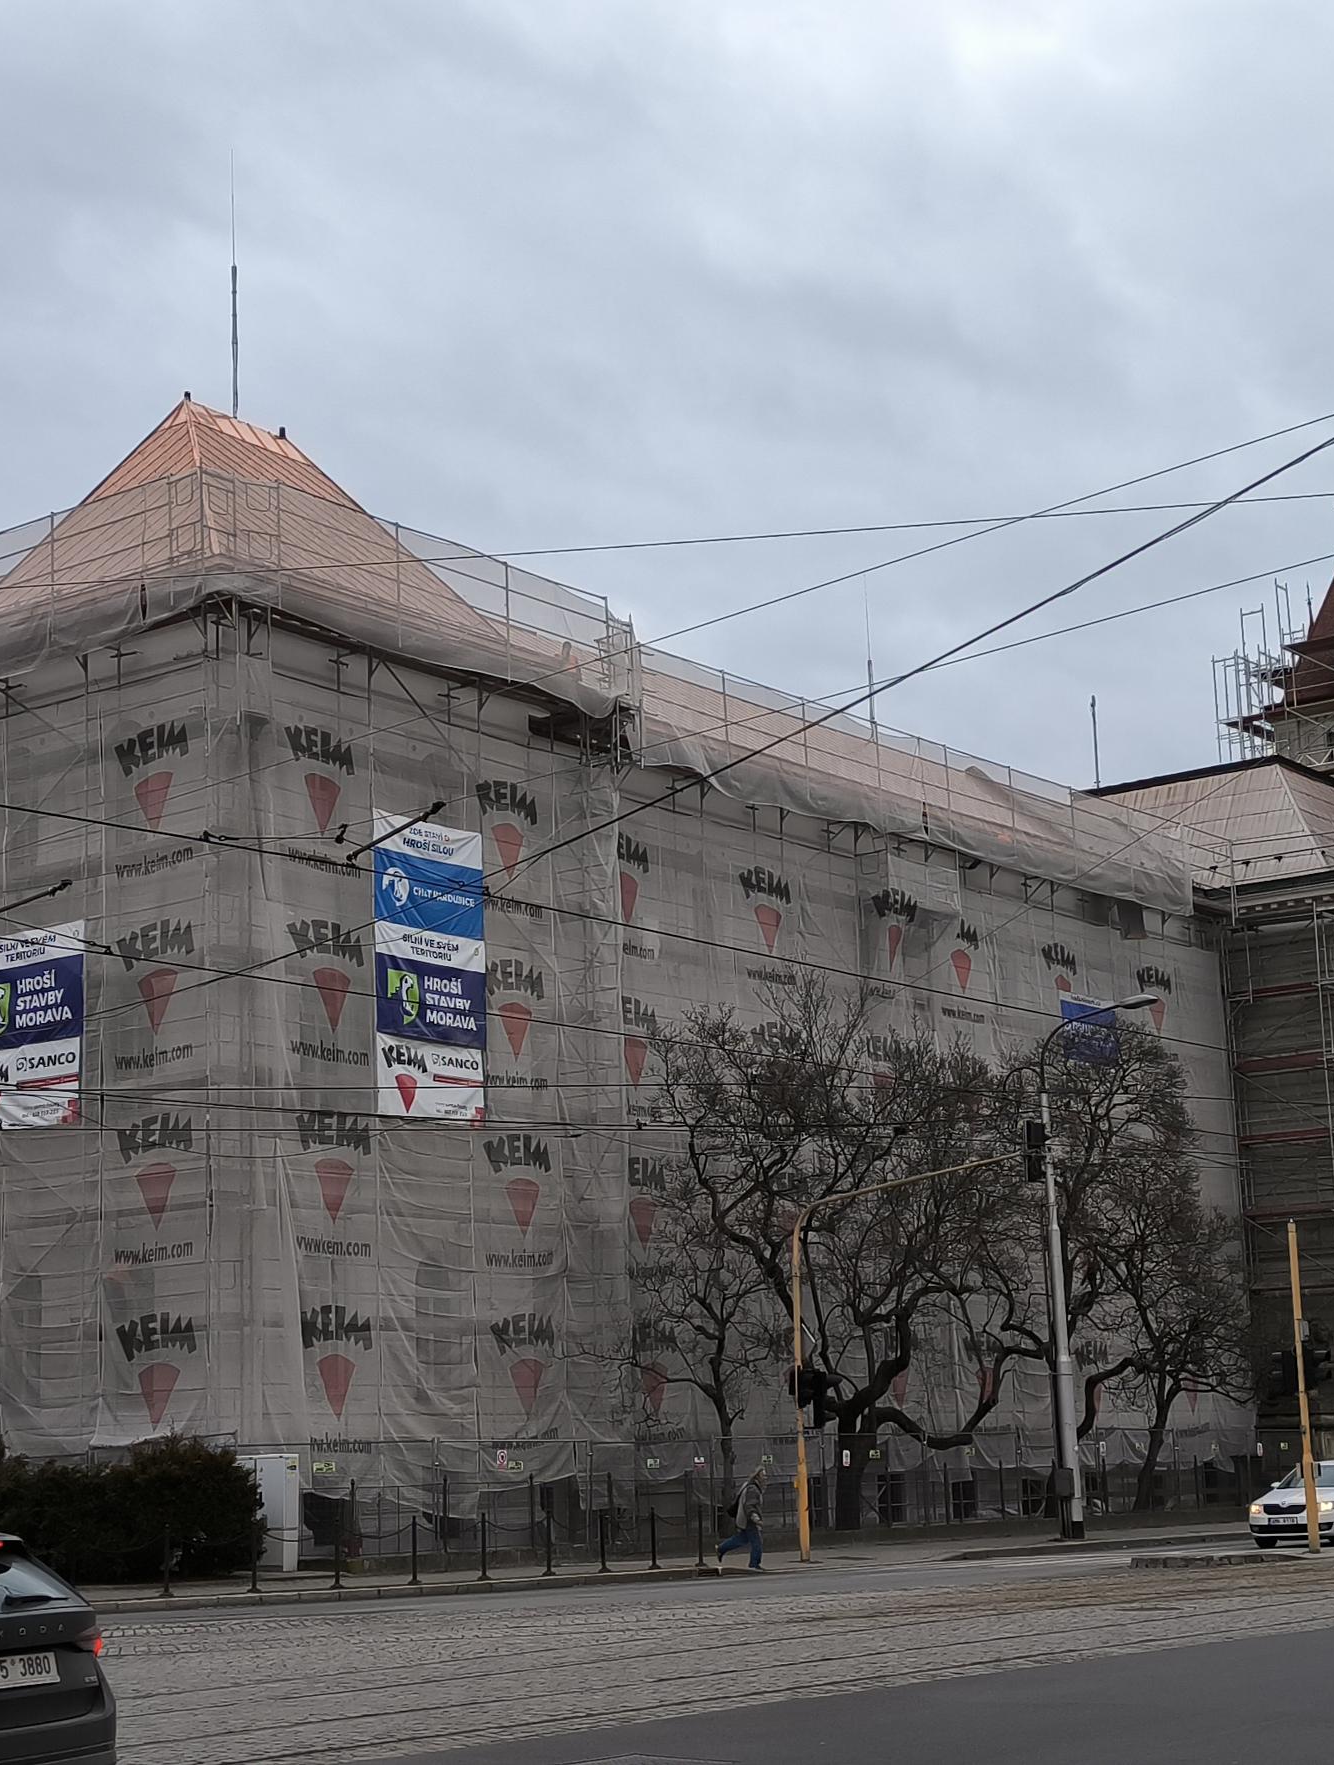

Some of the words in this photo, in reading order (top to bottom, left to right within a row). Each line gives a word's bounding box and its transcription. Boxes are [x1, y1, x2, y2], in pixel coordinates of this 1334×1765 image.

[114, 720, 189, 777] KEIM
[283, 724, 356, 776] KEIM
[475, 780, 538, 825] KEIM
[115, 846, 194, 880] www.keim.com
[431, 843, 454, 856] SILOU
[738, 866, 791, 905] KEIM
[116, 918, 195, 972] KEIM
[286, 918, 365, 968] KEIM
[17, 969, 55, 994] HROŠÍ
[424, 976, 462, 995] HROŠÍ
[1136, 965, 1171, 995] KEIM
[15, 989, 64, 1011] STAVBY
[425, 994, 471, 1012] STAVBY
[15, 1006, 72, 1029] MORAVA
[425, 1008, 477, 1031] MORAVA
[28, 1051, 76, 1070] SANCO
[115, 1042, 193, 1070] www.keim.com
[290, 1039, 369, 1067] www.keim.com
[381, 1045, 428, 1073] KEIM
[440, 1056, 479, 1070] SANCO
[117, 1113, 194, 1164] KEIM
[295, 1110, 371, 1156] KEIM
[482, 1133, 551, 1174] KEIM
[114, 1240, 194, 1264] www.keim.com
[485, 1248, 554, 1269] www.keim.com
[116, 1311, 196, 1362] KEIM
[301, 1304, 373, 1350] KEIM
[489, 1312, 555, 1357] KEIM
[19, 1655, 51, 1677] 3880
